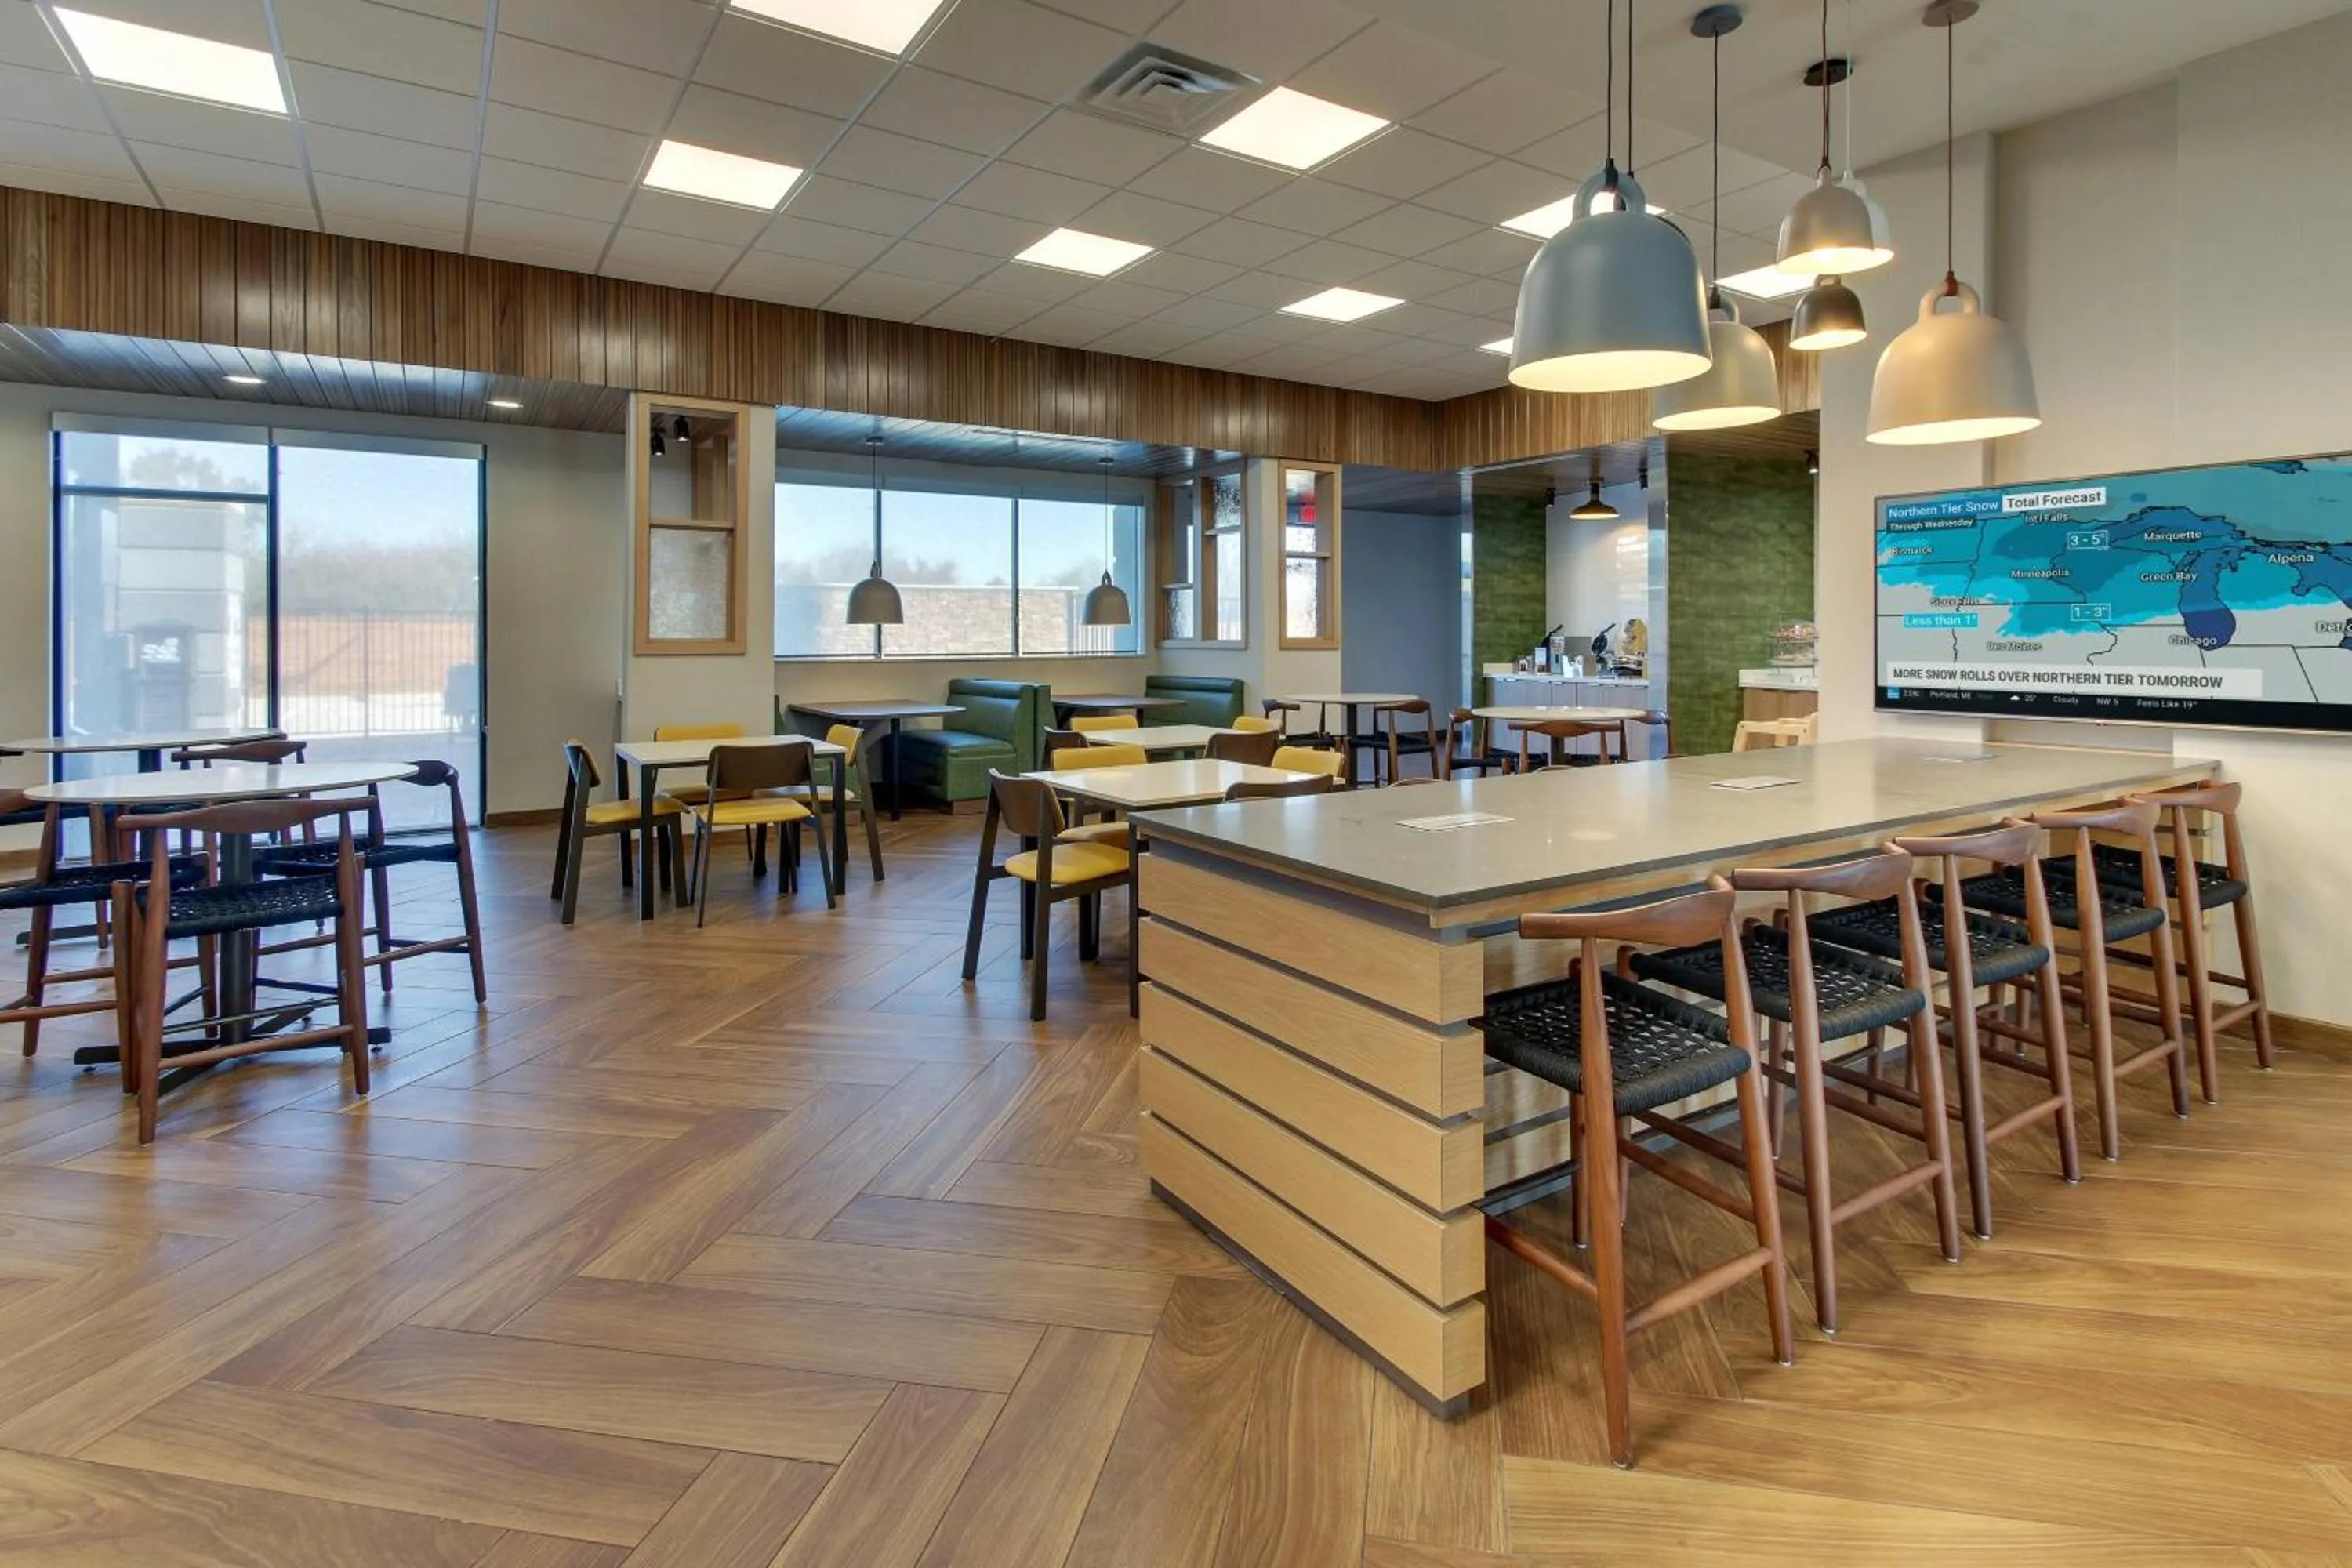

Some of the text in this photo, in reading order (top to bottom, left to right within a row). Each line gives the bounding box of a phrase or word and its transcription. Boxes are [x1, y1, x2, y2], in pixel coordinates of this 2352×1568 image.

[2006, 491, 2101, 509] Total Forecast
[1888, 502, 1999, 518] Northern Tier Snow
[1889, 518, 1973, 532] Through Wednesday
[2071, 535, 2079, 546] 3
[2144, 531, 2202, 542] Marquette
[1893, 546, 1933, 555] Bismarck
[2268, 554, 2314, 565] Alpena
[2011, 569, 2071, 579] Minneapolis
[2141, 572, 2198, 582] Green Bay
[1905, 616, 1933, 626] Less
[1935, 615, 1961, 626] than
[2168, 635, 2217, 646] Chicago
[1893, 668, 2223, 688] MORE SNOW ROLLS OVER NORTHERN TIER TOMORROW
